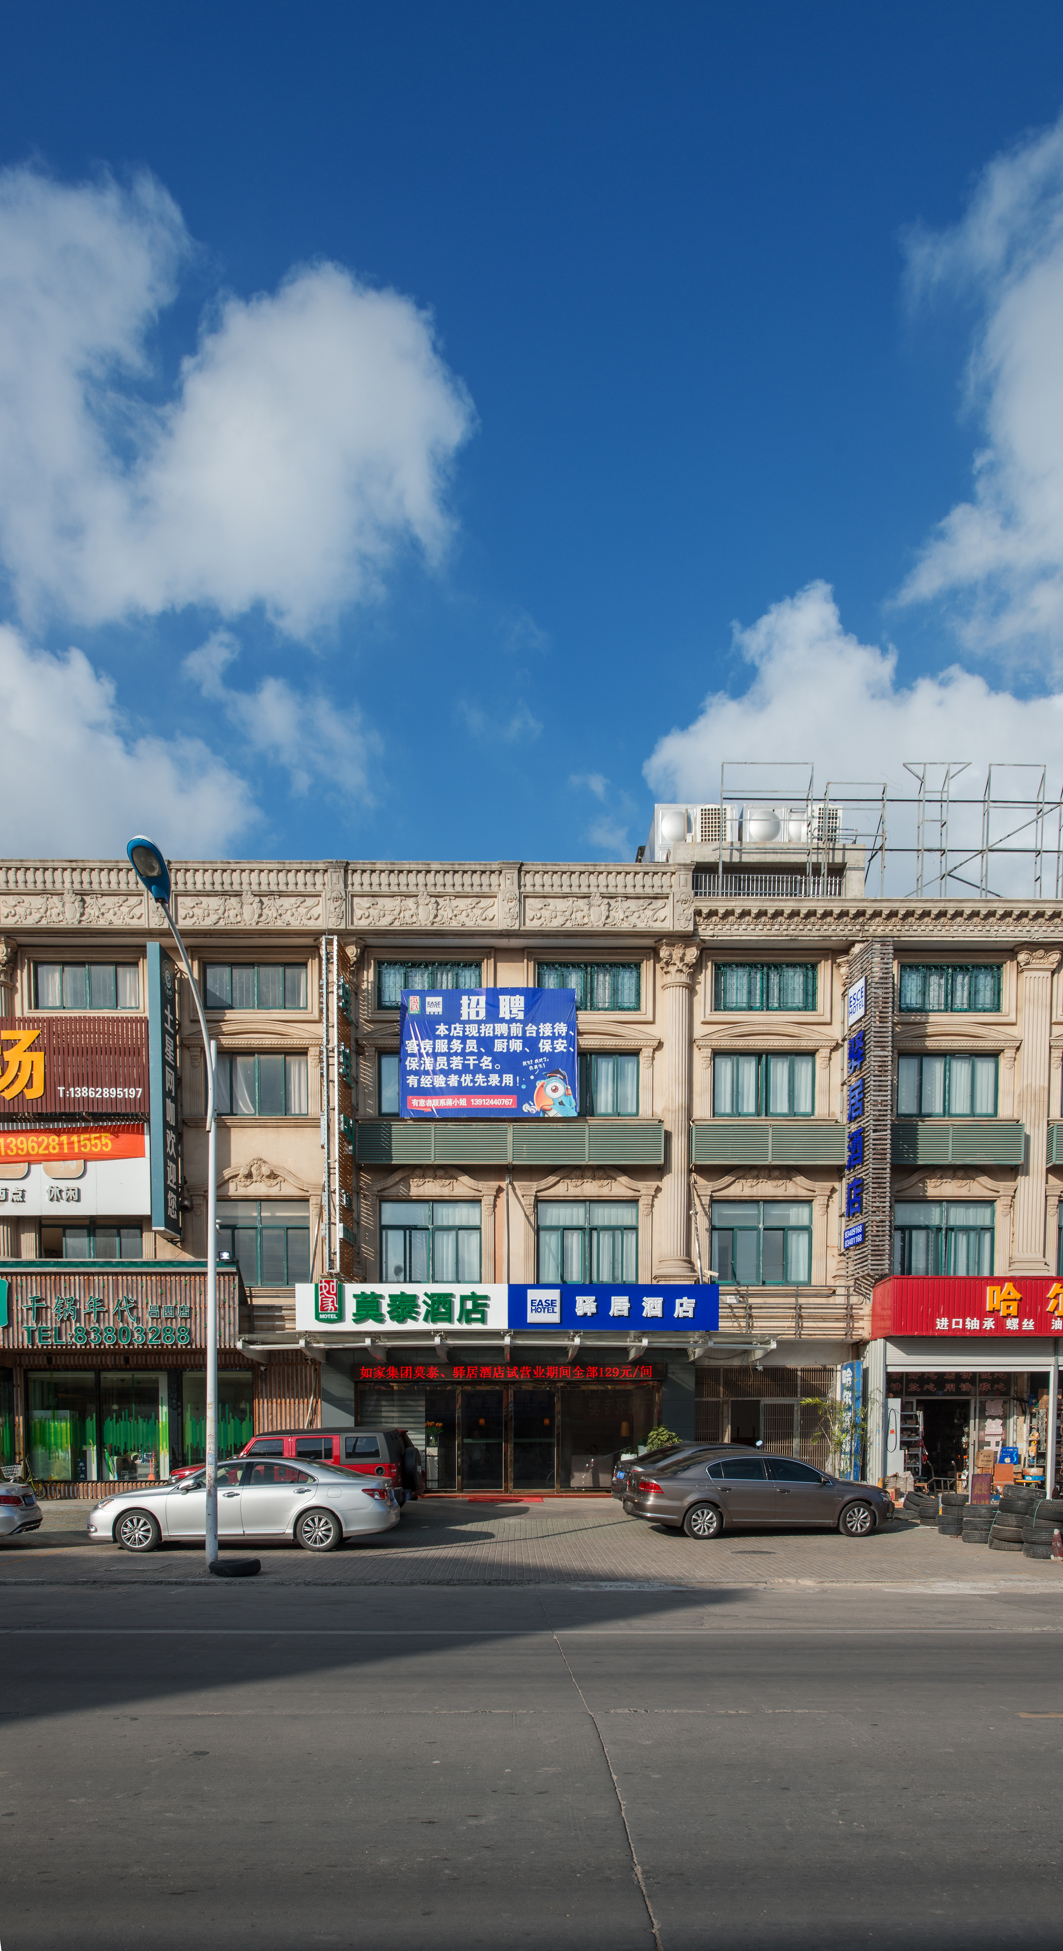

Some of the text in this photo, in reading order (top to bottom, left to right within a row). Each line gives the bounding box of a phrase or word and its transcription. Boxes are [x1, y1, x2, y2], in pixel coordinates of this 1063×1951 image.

[460, 995, 525, 1020] 招聘
[848, 1001, 864, 1017] HOTEL
[57, 1086, 143, 1099] T:13862895197
[47, 1186, 80, 1202] 休闲
[22, 1295, 190, 1323] 干锅年代 吕四店
[352, 1290, 490, 1324] 莫泰酒店
[530, 1299, 557, 1307] EASE
[575, 1296, 698, 1319] 驿居酒店
[935, 1317, 996, 1331] 进口轴承
[1005, 1317, 1036, 1331] 螺丝
[22, 1325, 191, 1345] TEL:83803288
